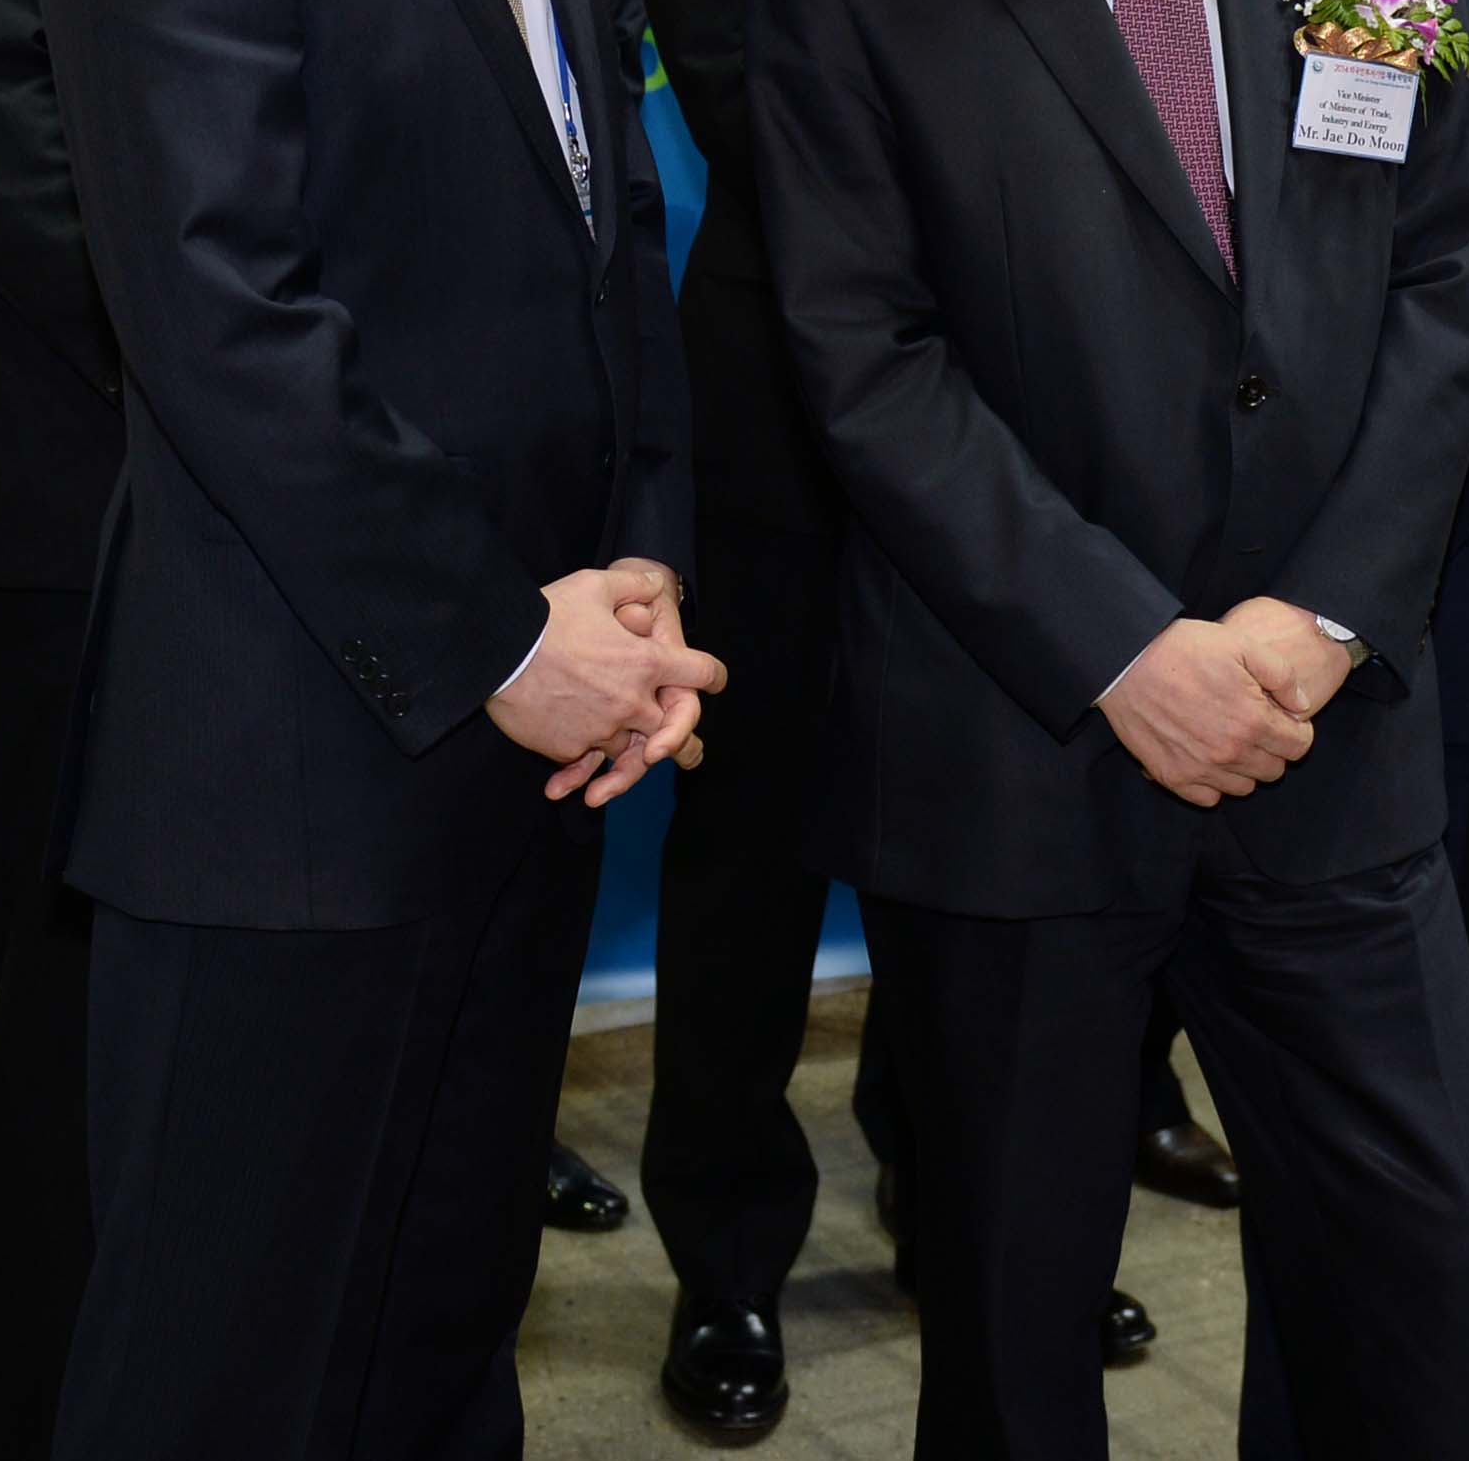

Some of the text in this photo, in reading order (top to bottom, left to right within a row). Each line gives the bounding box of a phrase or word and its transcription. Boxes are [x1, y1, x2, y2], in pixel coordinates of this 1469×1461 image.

[1337, 89, 1382, 104] Vice Minister
[1321, 114, 1388, 134] Industry and Energy
[1298, 125, 1319, 140] Mr.
[1347, 133, 1365, 146] Do
[1369, 135, 1405, 153] Moon
